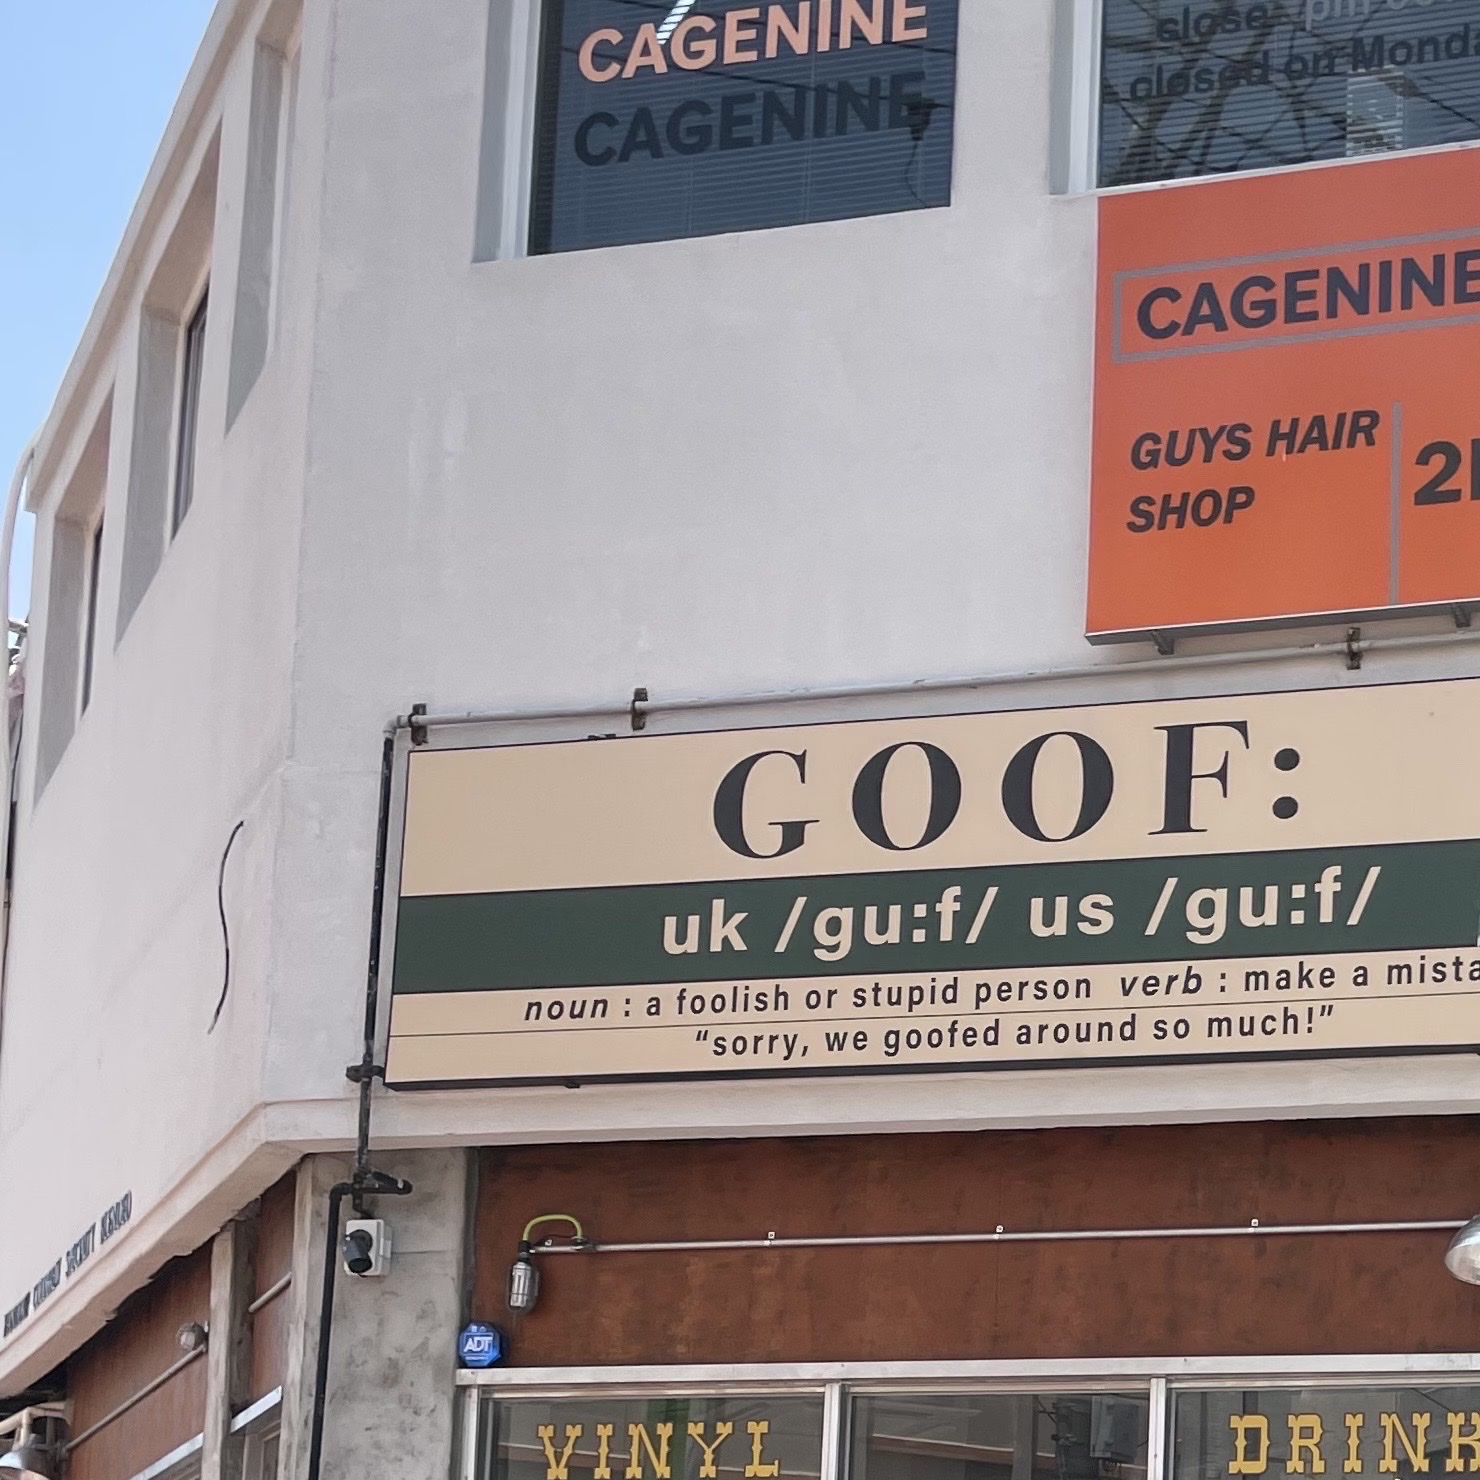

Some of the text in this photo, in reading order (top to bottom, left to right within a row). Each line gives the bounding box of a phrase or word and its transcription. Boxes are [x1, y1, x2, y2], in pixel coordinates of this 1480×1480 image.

[578, 0, 928, 83] CAGENINE
[1129, 409, 1381, 471] GUYS HAIR
[1126, 486, 1255, 533] SHOP
[713, 719, 1301, 859] GOOF:
[662, 864, 1382, 963] uk /gu:f/ us /gu:f/
[523, 994, 609, 1022] noun
[646, 994, 661, 1018] a
[676, 985, 790, 1016] foolish
[804, 985, 838, 1012] or
[852, 976, 959, 1016] stupid
[973, 975, 1091, 1011] person
[1119, 966, 1202, 998] verb
[1243, 960, 1336, 994] make
[1352, 964, 1369, 987] a
[824, 1028, 869, 1053] we
[883, 1017, 1000, 1057] goofed
[1016, 1013, 1137, 1045] around
[1153, 1015, 1191, 1040] so
[463, 1336, 493, 1353] ADT
[536, 1420, 780, 1480] VINYL
